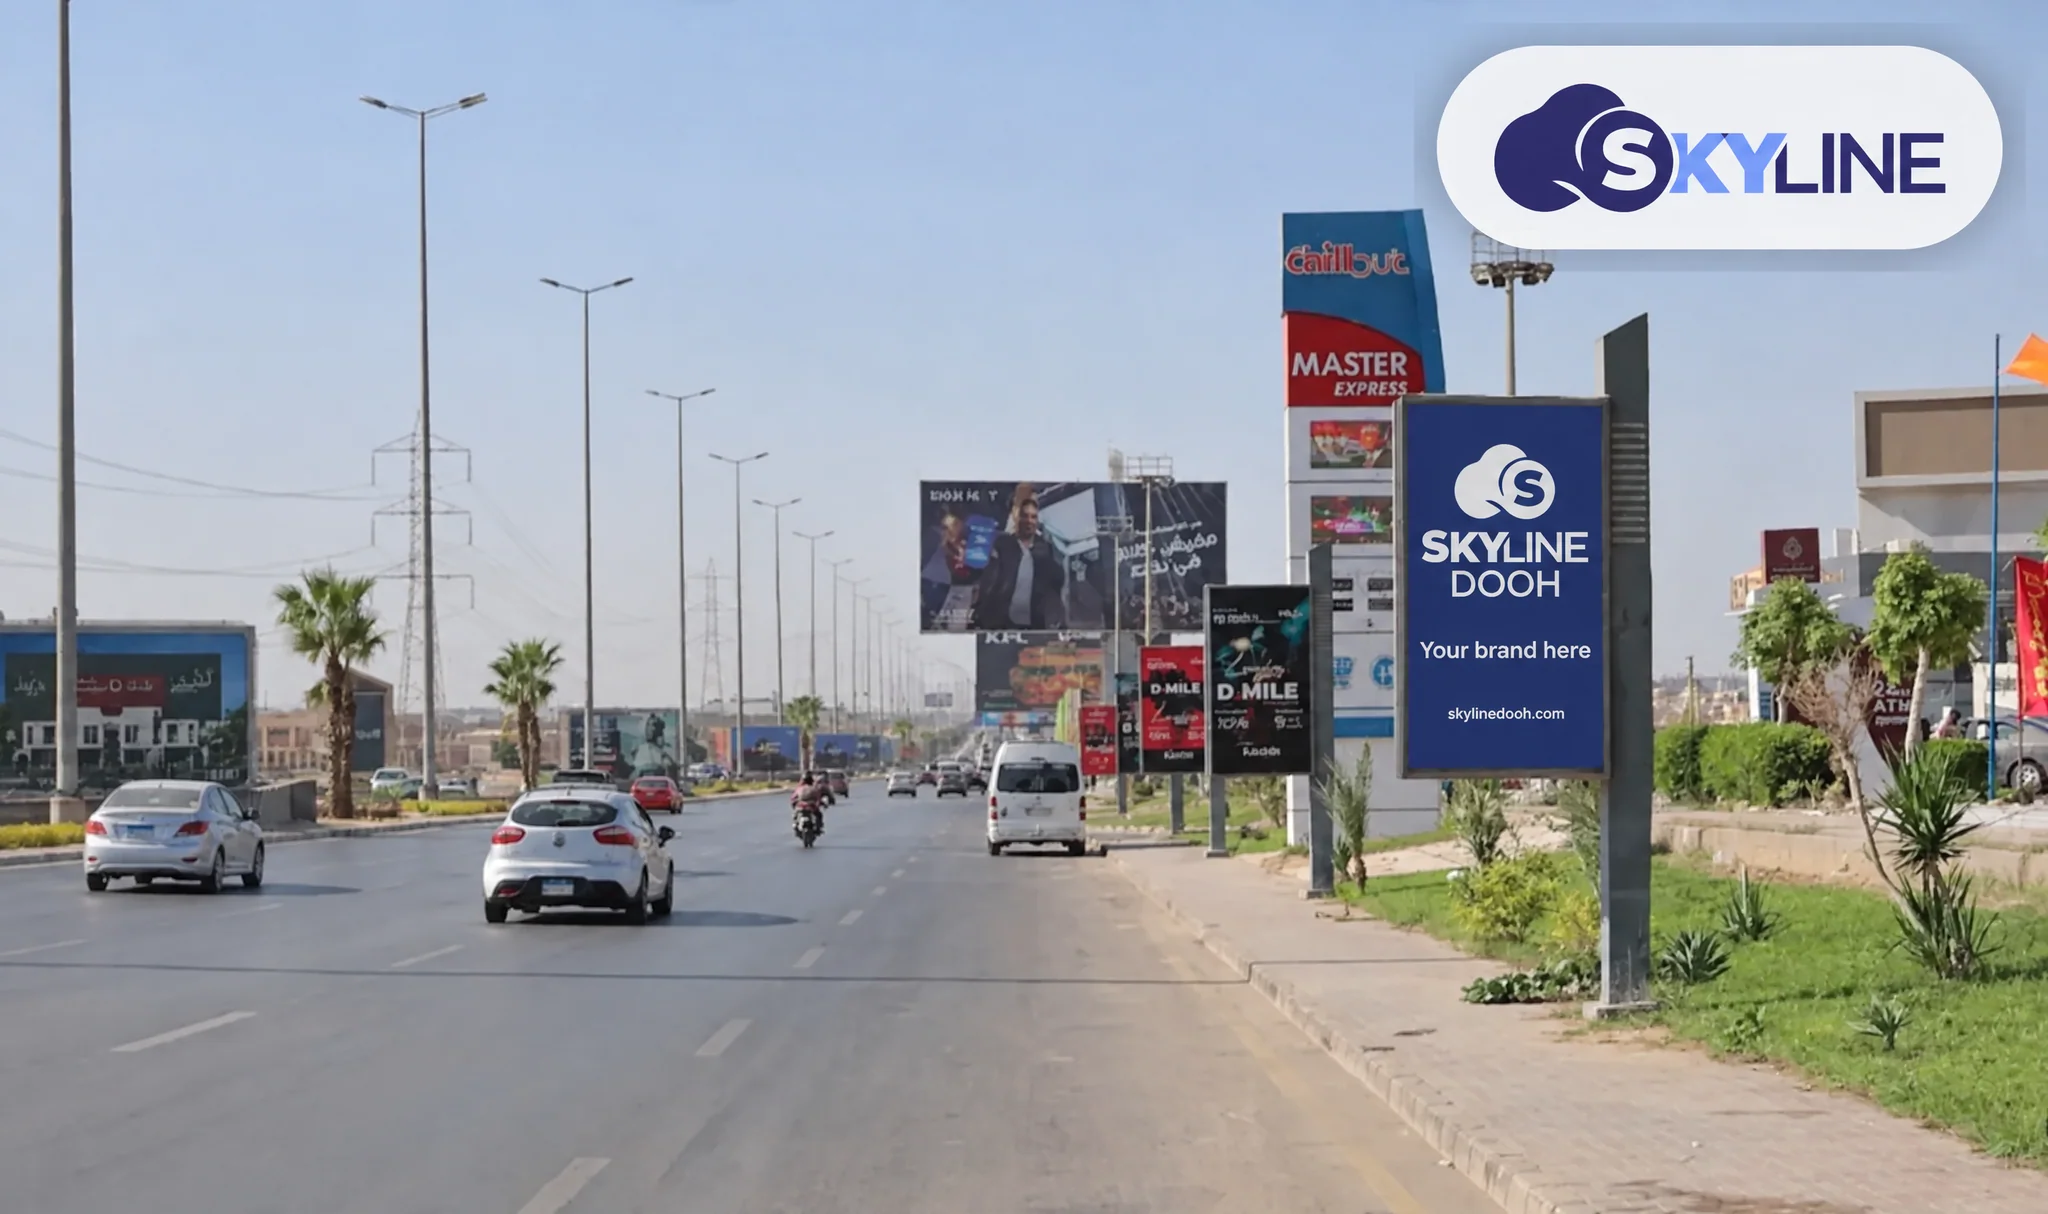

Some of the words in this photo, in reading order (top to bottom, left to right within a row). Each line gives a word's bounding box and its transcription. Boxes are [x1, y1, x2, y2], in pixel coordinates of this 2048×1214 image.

[1291, 352, 1408, 377] MASTER
[1334, 381, 1409, 397] EXPRESS
[1421, 529, 1589, 563] SKYLINE
[1451, 569, 1560, 598] DOOH
[1420, 641, 1469, 659] Your
[1474, 640, 1537, 659] brand
[1543, 640, 1592, 659] here
[1447, 707, 1565, 723] skylinedooh.com
